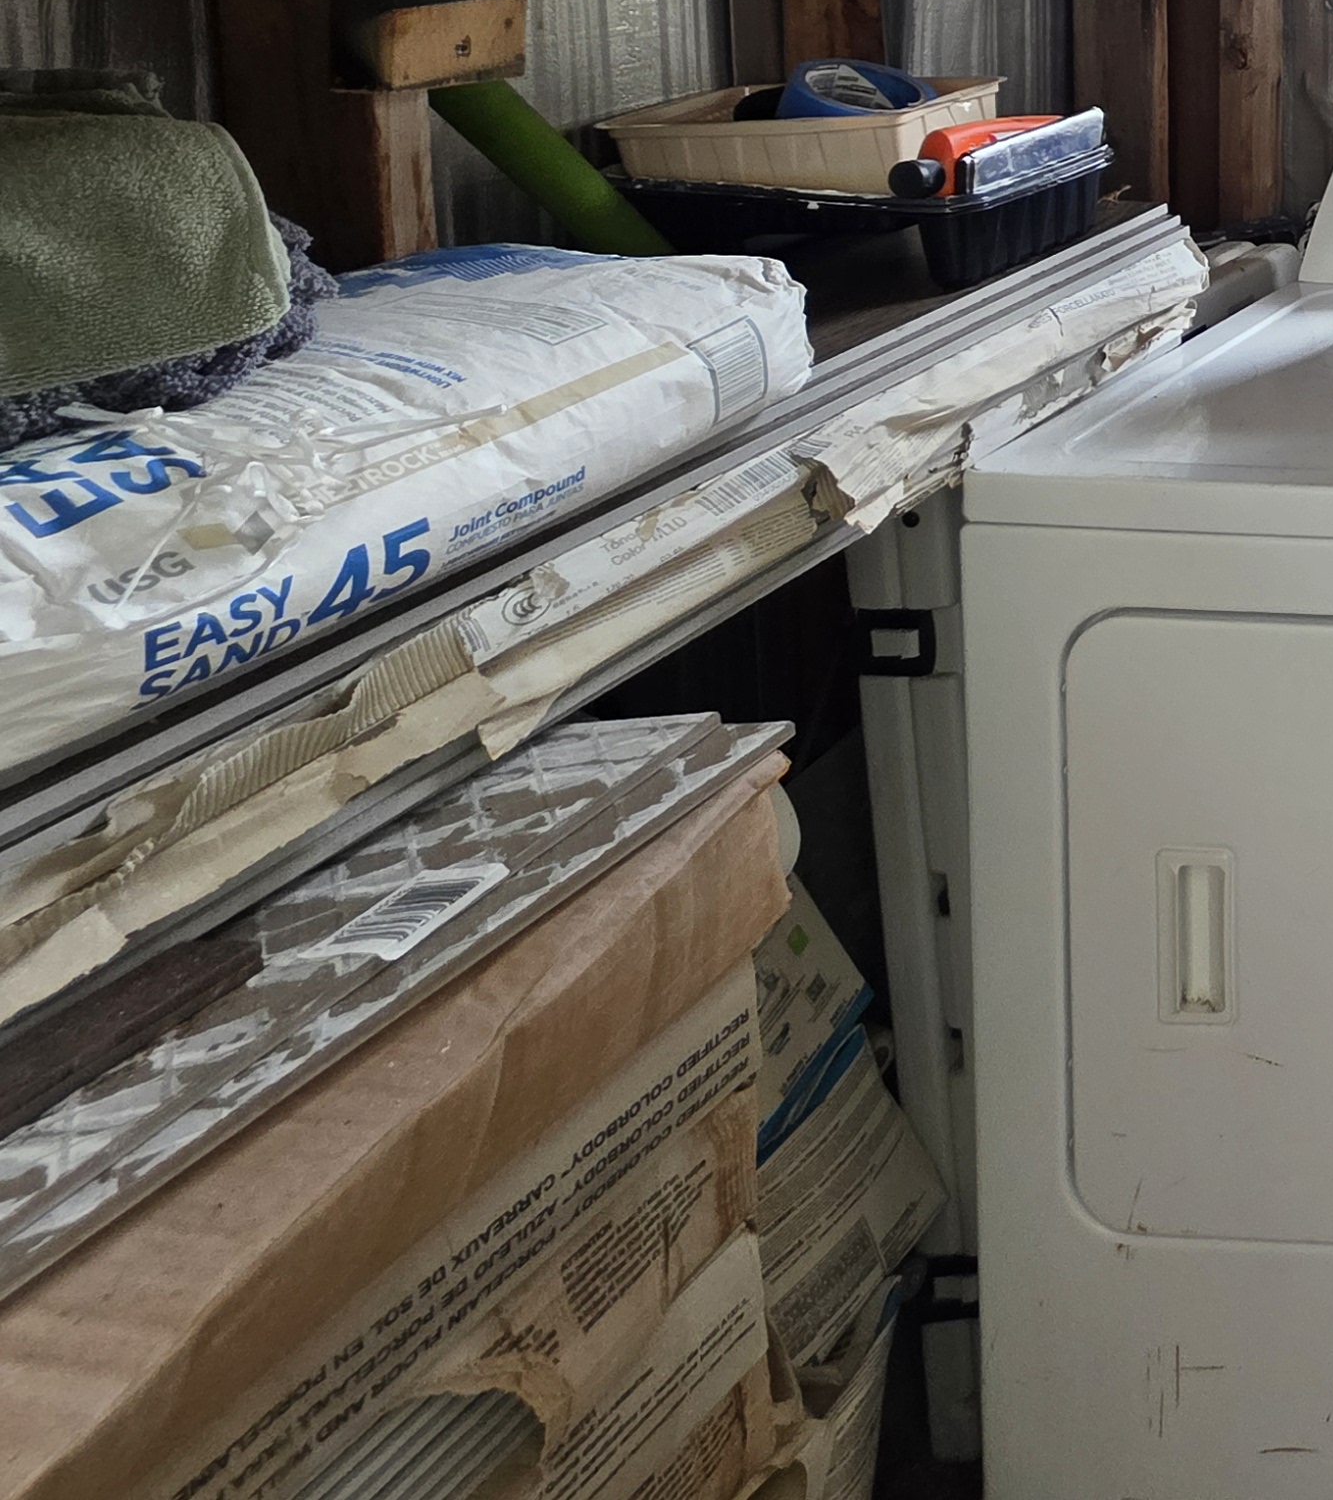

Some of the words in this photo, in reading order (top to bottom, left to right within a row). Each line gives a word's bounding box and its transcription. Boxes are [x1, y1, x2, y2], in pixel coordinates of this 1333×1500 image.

[446, 514, 511, 554] COMPUESTO
[513, 502, 544, 523] PARA
[546, 483, 584, 508] JUNTAS
[449, 510, 492, 543] Joint
[495, 466, 586, 518] Compound
[87, 551, 195, 604] USG
[305, 517, 431, 627] 45
[139, 617, 302, 698] SAND
[144, 575, 294, 673] EASY
[675, 1008, 750, 1079] RECTIFIED
[676, 1032, 751, 1105] RECTIFIED
[675, 1055, 750, 1129] RECTIFIED
[450, 1172, 557, 1274] CARREAUX
[473, 1197, 560, 1282] AZULEJO
[370, 1294, 415, 1336] SOL
[416, 1264, 448, 1300] DE
[442, 1276, 470, 1310] DE
[448, 1225, 557, 1332] PORCELAIN
[333, 1335, 366, 1372] EN
[371, 1324, 444, 1401] FLOOR
[315, 1391, 369, 1444] AND
